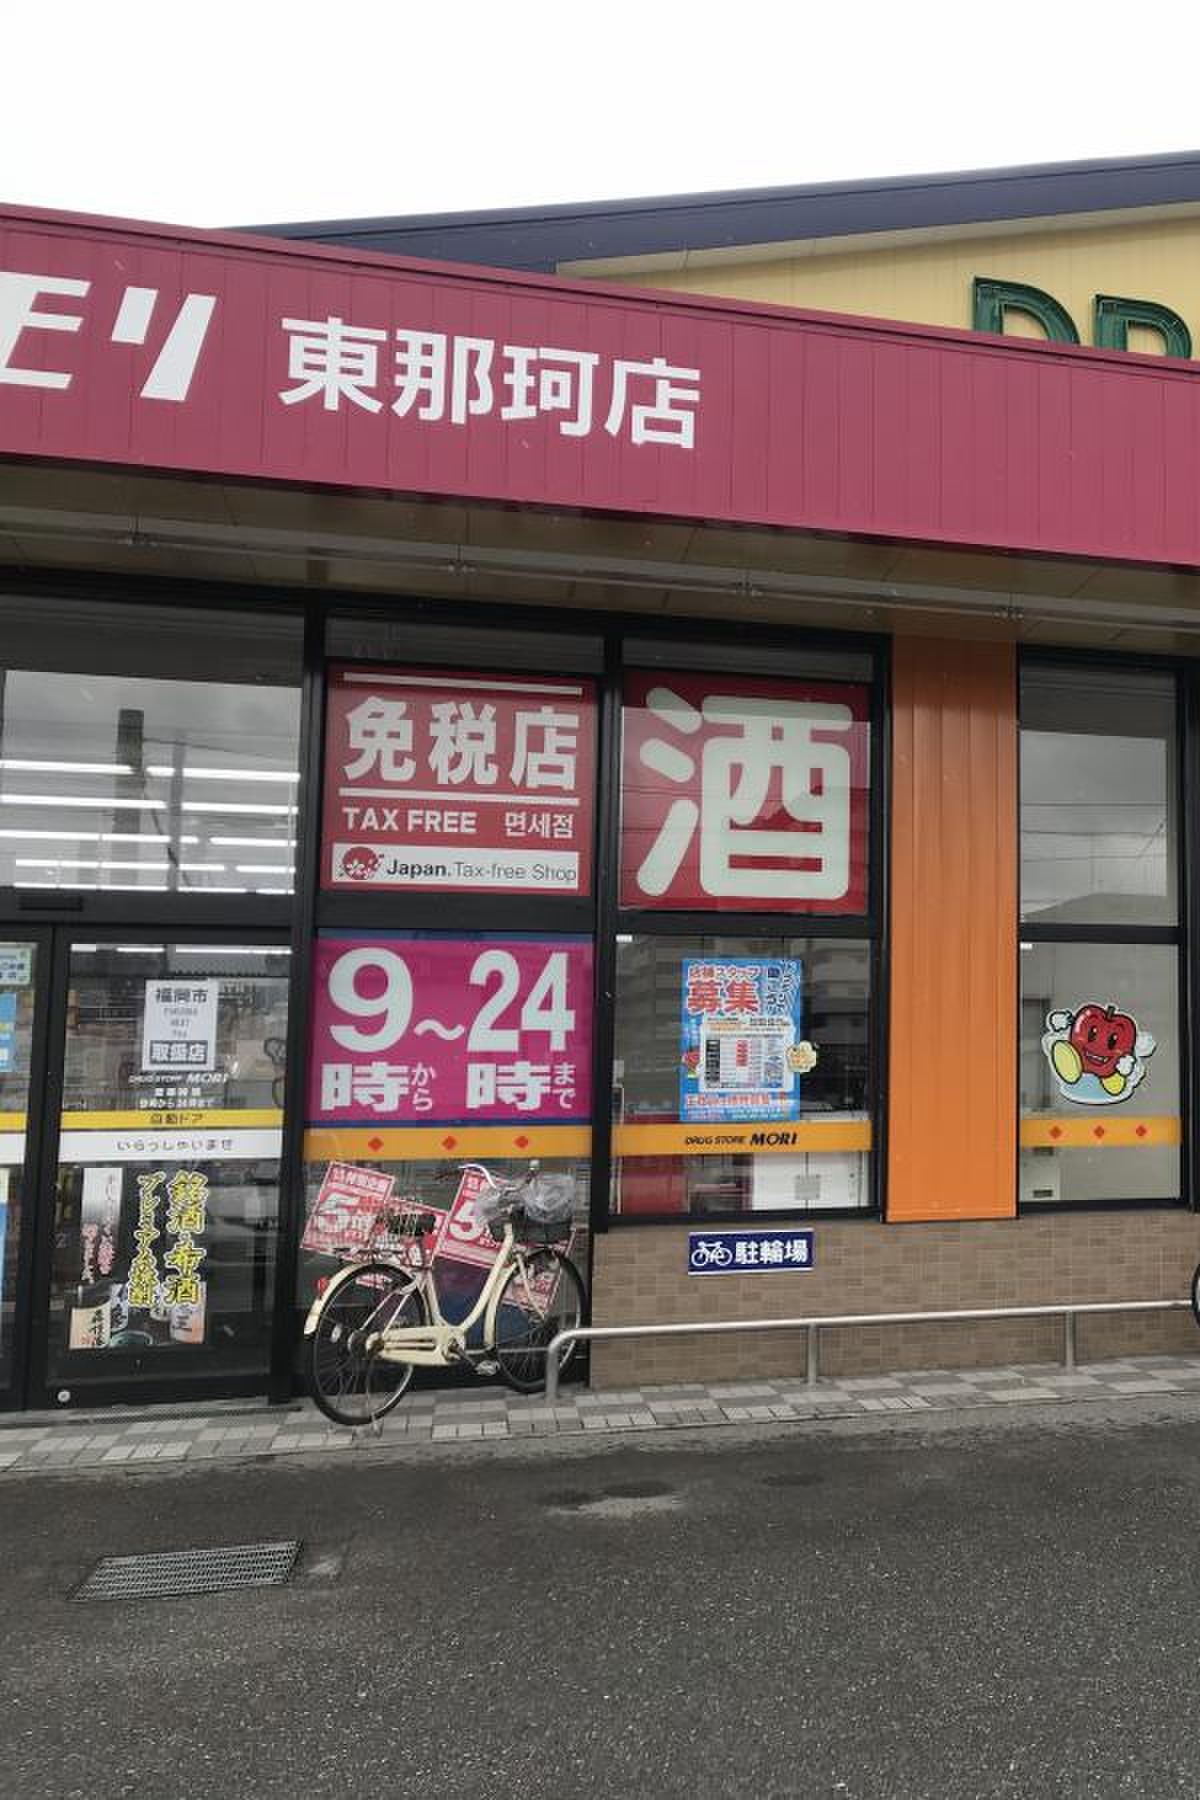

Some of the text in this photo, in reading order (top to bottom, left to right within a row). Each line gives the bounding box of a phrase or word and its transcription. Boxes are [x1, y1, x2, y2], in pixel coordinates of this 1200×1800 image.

[278, 316, 700, 449] 東那珂店
[342, 695, 580, 791] 免税店
[637, 686, 852, 901] 酒
[342, 807, 478, 833] TAX FREE
[504, 811, 574, 839] 면세점
[454, 861, 526, 879] Tax-free
[531, 864, 577, 884] Shop
[687, 980, 758, 1013] 募集
[749, 1132, 798, 1146] MORI
[735, 1239, 809, 1265] 駐輪場
